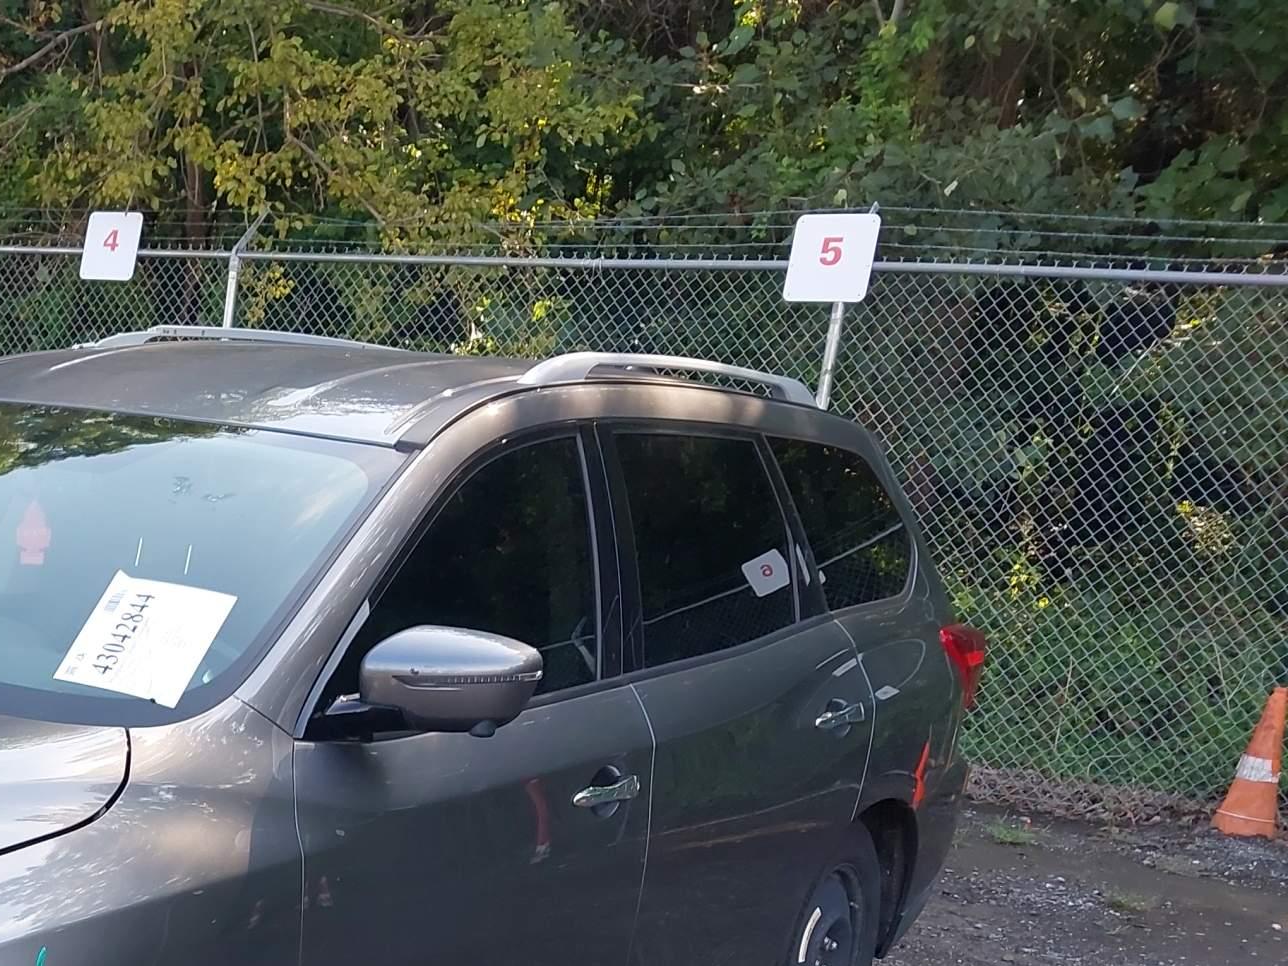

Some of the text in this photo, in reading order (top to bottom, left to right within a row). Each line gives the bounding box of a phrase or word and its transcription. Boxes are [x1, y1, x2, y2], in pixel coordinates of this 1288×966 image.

[103, 229, 119, 252] 4
[819, 236, 844, 266] 5
[92, 593, 156, 675] 43042844
